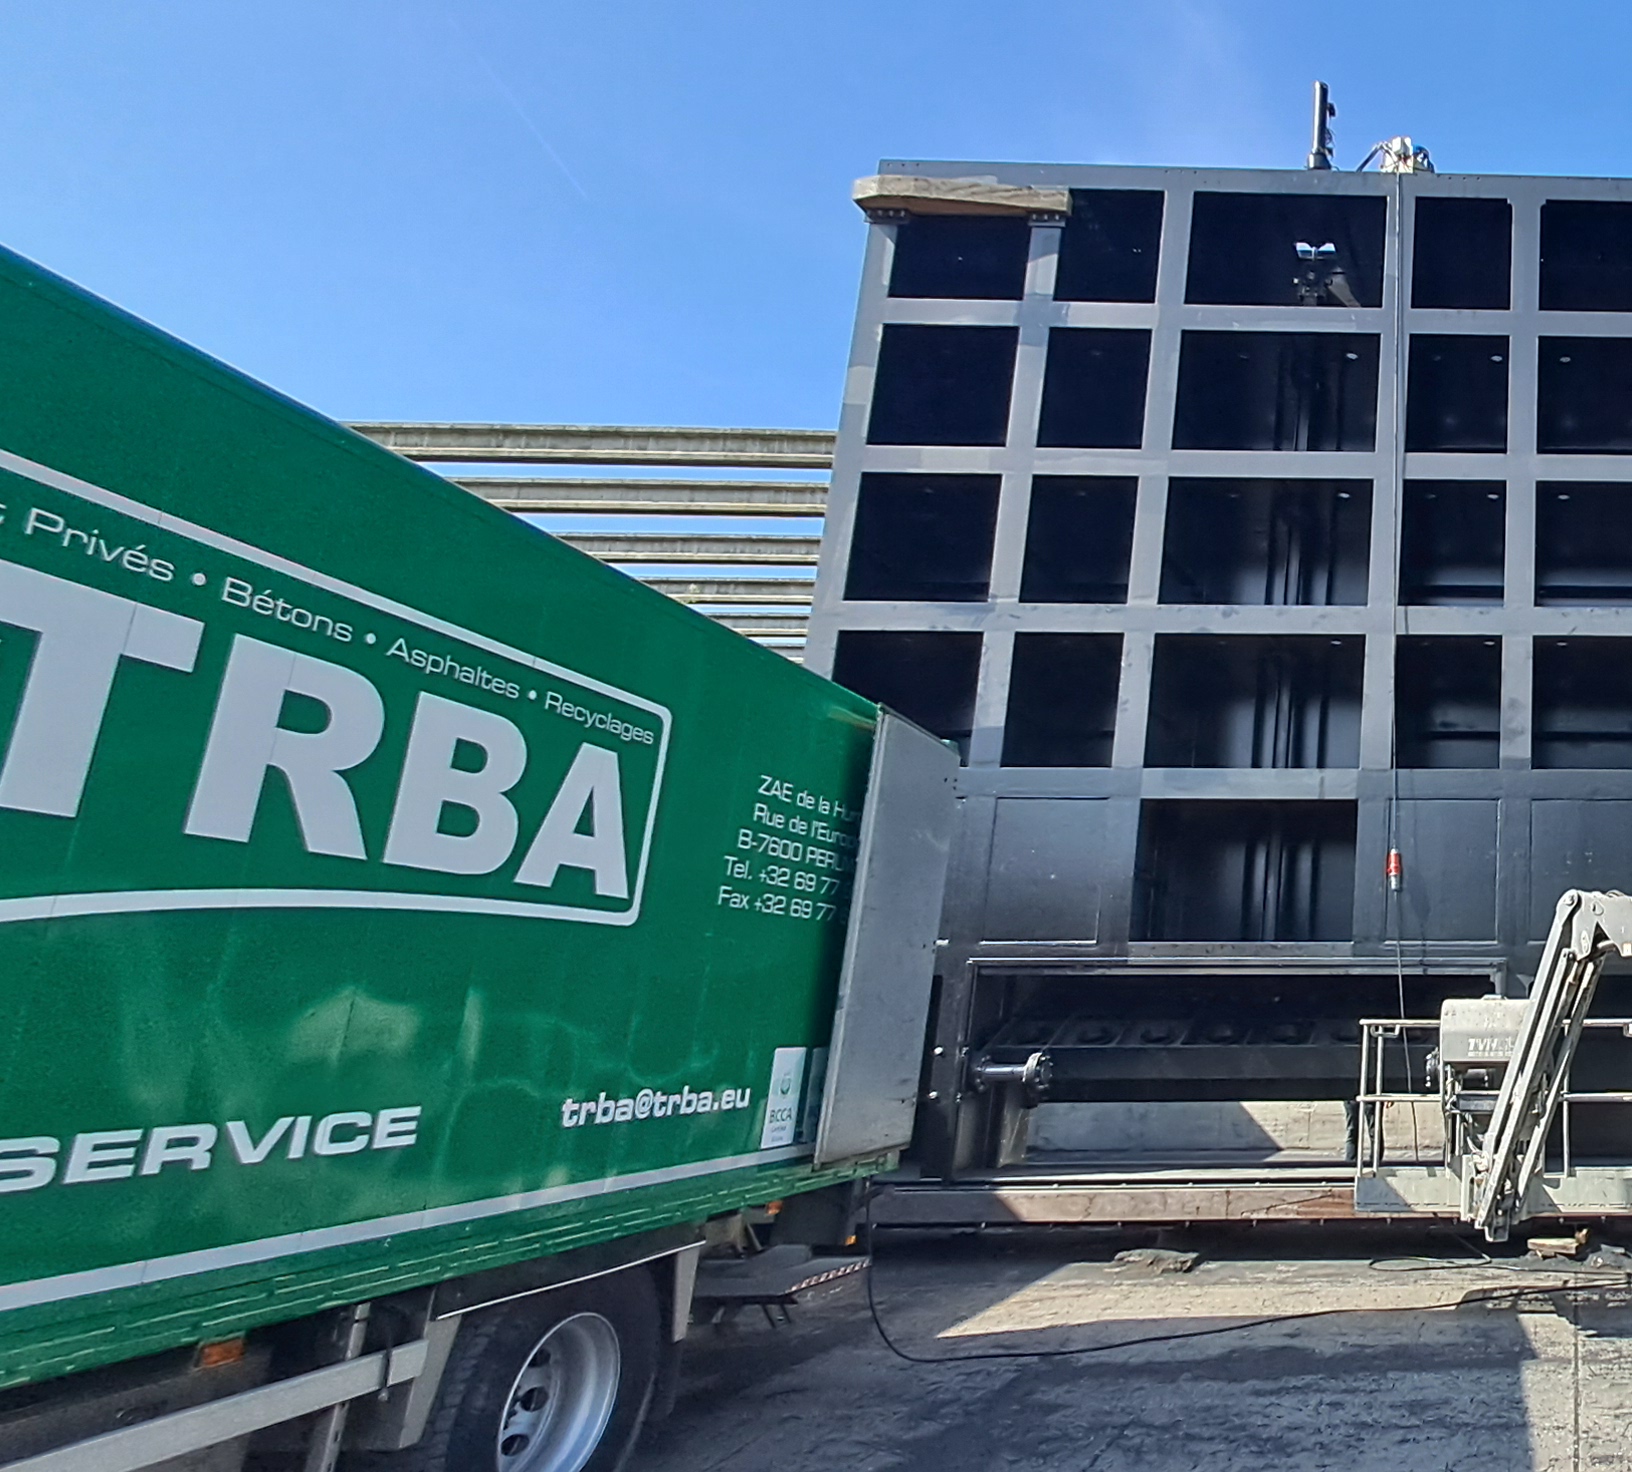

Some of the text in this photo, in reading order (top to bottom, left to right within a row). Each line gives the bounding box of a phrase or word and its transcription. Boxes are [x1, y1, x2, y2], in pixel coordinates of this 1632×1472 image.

[25, 506, 654, 745] Privés Bétons Asphaltes Recyclages
[0, 556, 629, 899] TRBA
[758, 774, 794, 803] ZAE
[796, 790, 815, 810] de
[818, 795, 830, 815] la
[753, 803, 785, 829] Rue
[789, 815, 808, 835] de
[737, 828, 802, 862] B-7600
[724, 855, 752, 880] Tel.
[758, 865, 790, 888] +32
[793, 871, 816, 892] 69
[820, 876, 840, 895] 77
[717, 885, 750, 910] Fax
[754, 893, 786, 915] +32
[790, 898, 813, 919] 69
[816, 902, 837, 921] 77
[561, 1085, 751, 1127] trba@trba.eu
[769, 1108, 792, 1123] BCCA
[0, 1105, 422, 1193] SERVICE
